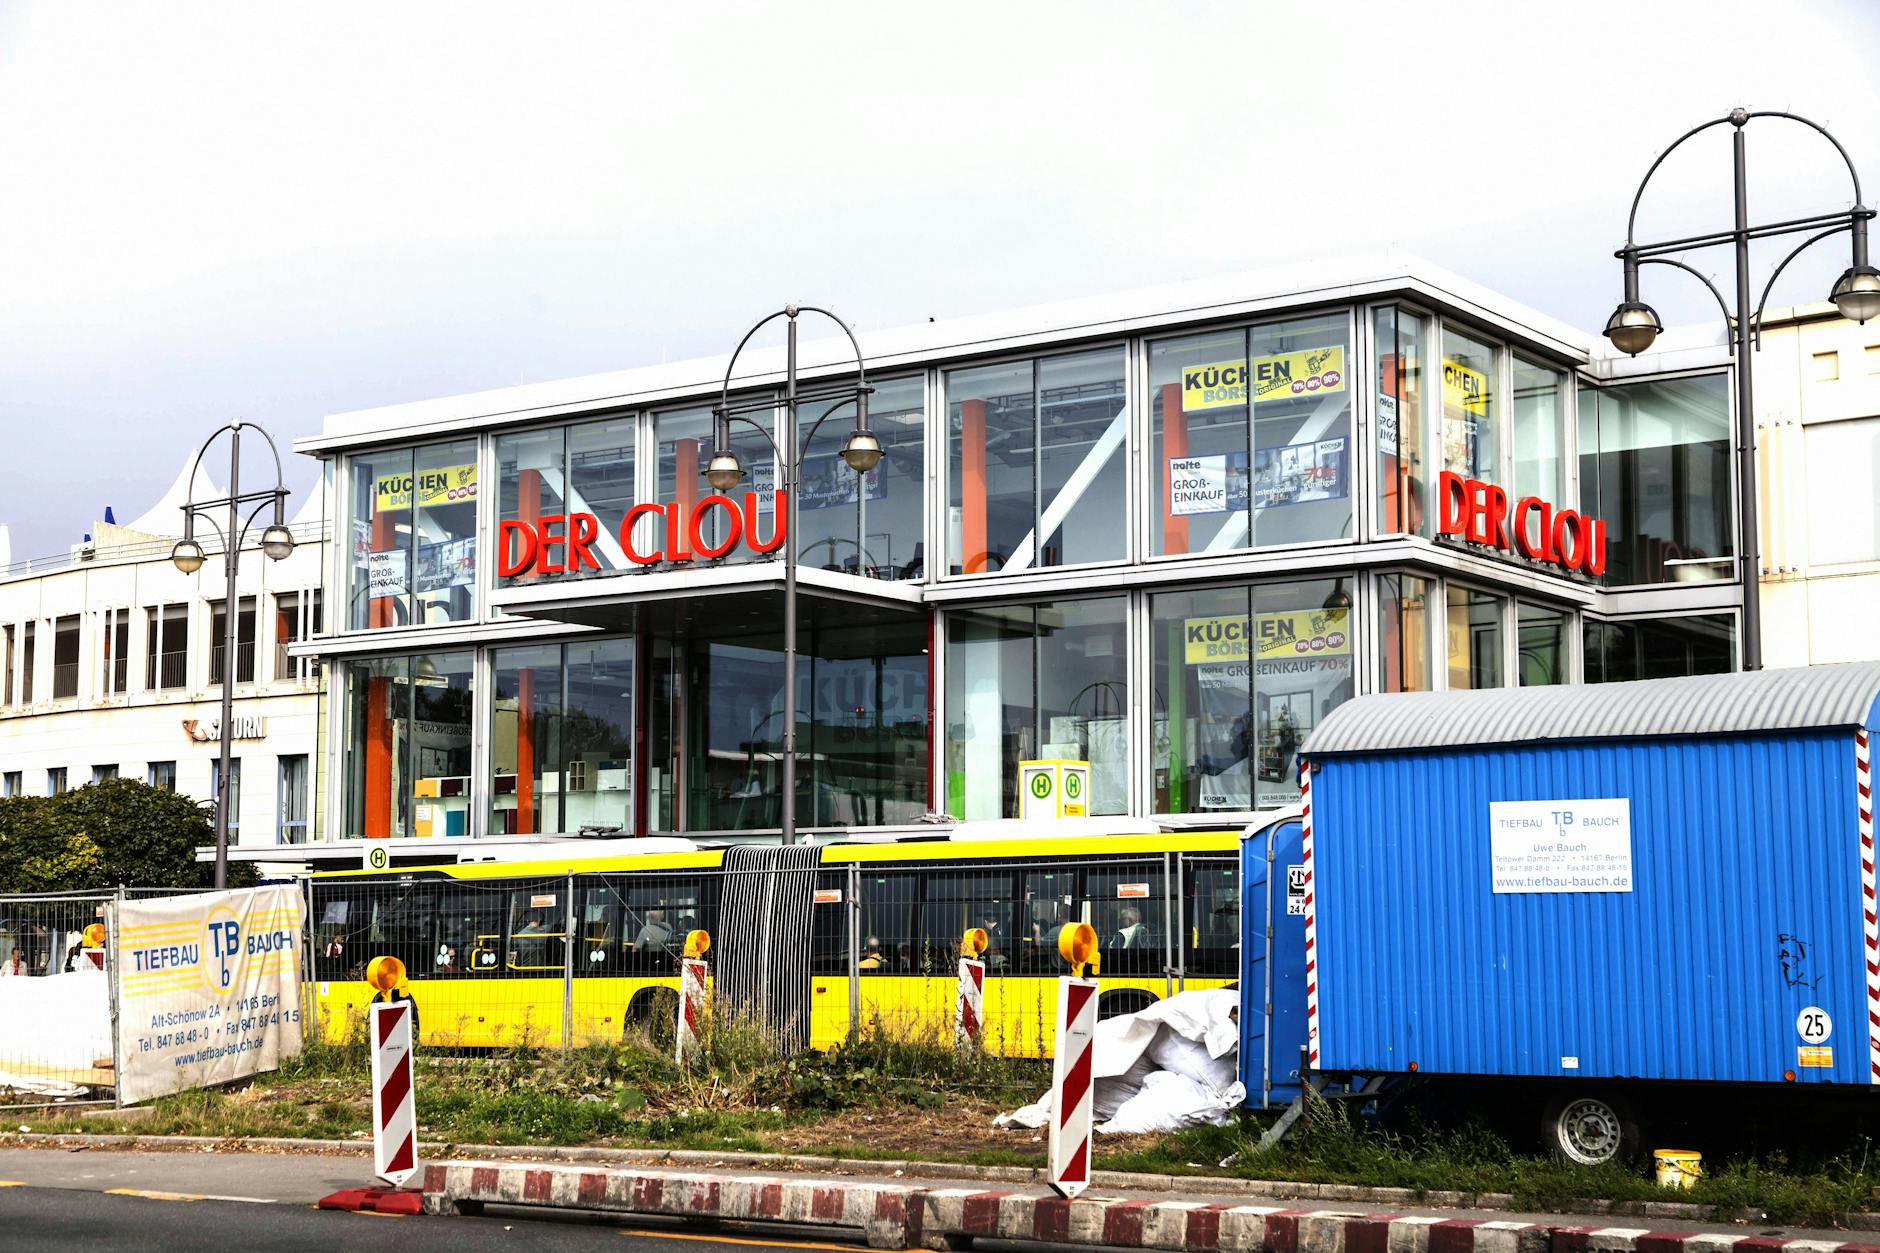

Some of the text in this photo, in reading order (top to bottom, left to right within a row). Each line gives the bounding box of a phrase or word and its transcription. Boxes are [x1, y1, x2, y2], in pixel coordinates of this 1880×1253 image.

[1185, 360, 1290, 391] KÜCHEN
[1323, 373, 1340, 384] 90%
[1444, 366, 1479, 397] CHEN
[1172, 460, 1201, 470] nolte
[378, 473, 447, 495] KÜCHEN
[754, 483, 774, 493] GRO
[1239, 490, 1248, 498] 50
[1255, 484, 1297, 497] usterküchen
[390, 491, 431, 506] BÖRE
[1174, 490, 1224, 503] EINKAUF
[498, 488, 787, 577] DER CLOU
[1437, 471, 1606, 577] DER CLOU
[370, 577, 404, 589] EINKAUF
[1187, 618, 1295, 643] KÜCHEN
[1327, 634, 1345, 645] 90%
[1319, 657, 1349, 672] 70%
[800, 668, 928, 713] KÜCH
[207, 716, 268, 741] SURN
[1500, 819, 1543, 828] TIEFBAU
[1583, 817, 1620, 827] BAUCH
[1533, 843, 1587, 853] Uwe Bauch
[1581, 864, 1594, 872] 847
[1496, 875, 1628, 887] www.tiefbau-bauch.de
[133, 944, 199, 971] TIEFBAU
[247, 931, 293, 955] BAUCH
[151, 1009, 207, 1029] Alt-Schönow
[208, 1004, 220, 1019] 2A
[1804, 1014, 1825, 1037] 25
[138, 1037, 155, 1053] Tel.
[157, 1034, 173, 1049] 847
[175, 1031, 185, 1046] 88
[174, 1035, 264, 1067] www.tiefbau-bauch.de
